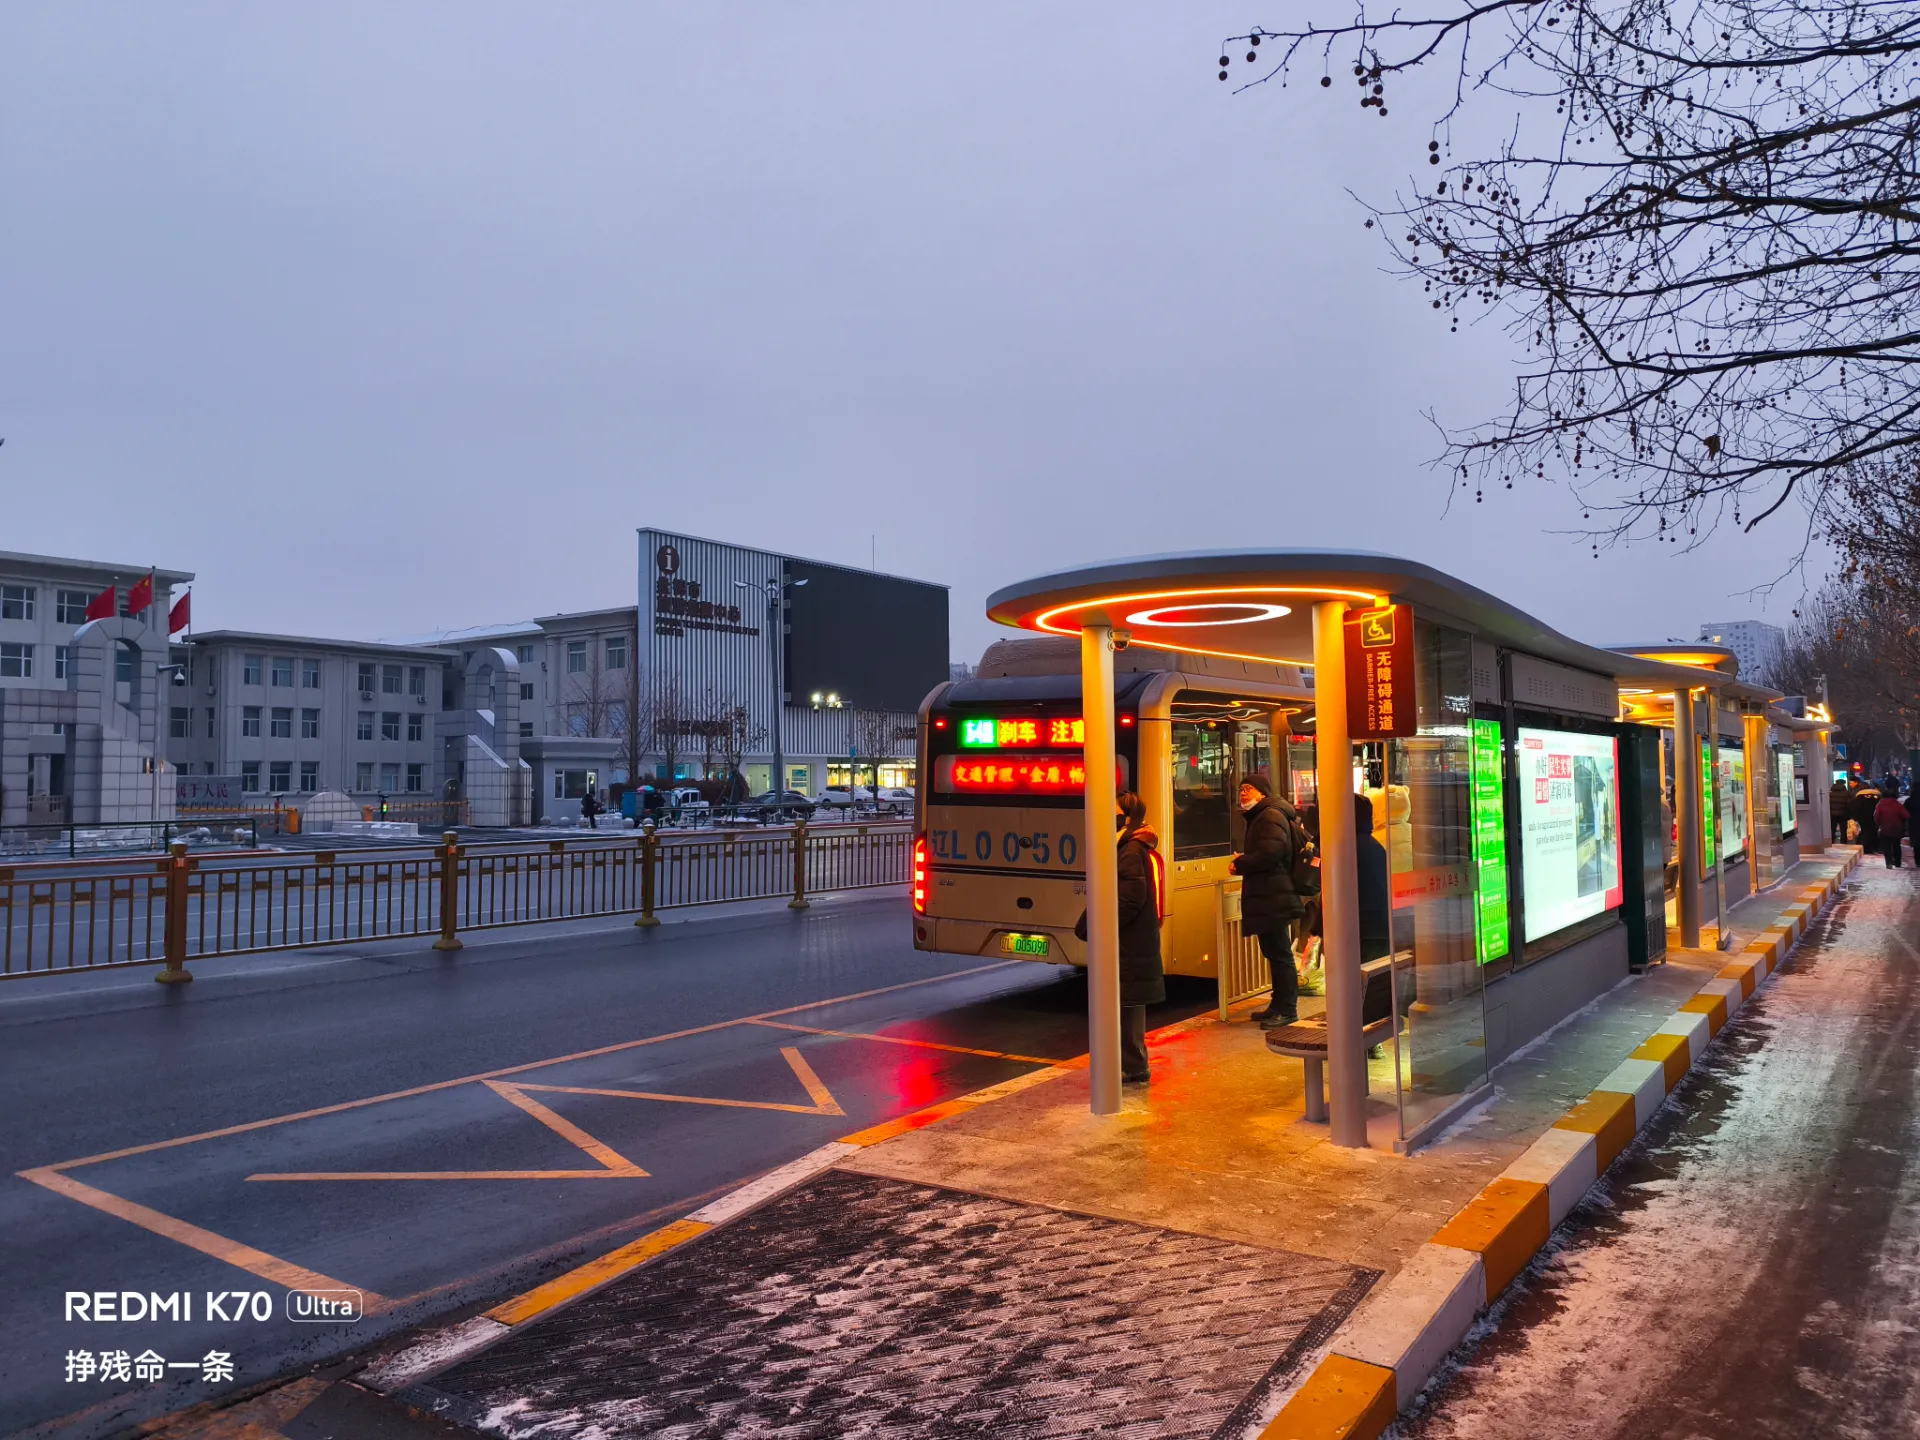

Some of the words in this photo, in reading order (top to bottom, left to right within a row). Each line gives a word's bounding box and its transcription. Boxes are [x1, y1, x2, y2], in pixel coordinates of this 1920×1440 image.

[1366, 653, 1375, 702] BARRIER-FREE
[1376, 651, 1394, 731] 无障碍通道
[999, 720, 1037, 743] 刹车
[1367, 703, 1376, 731] ACCESS
